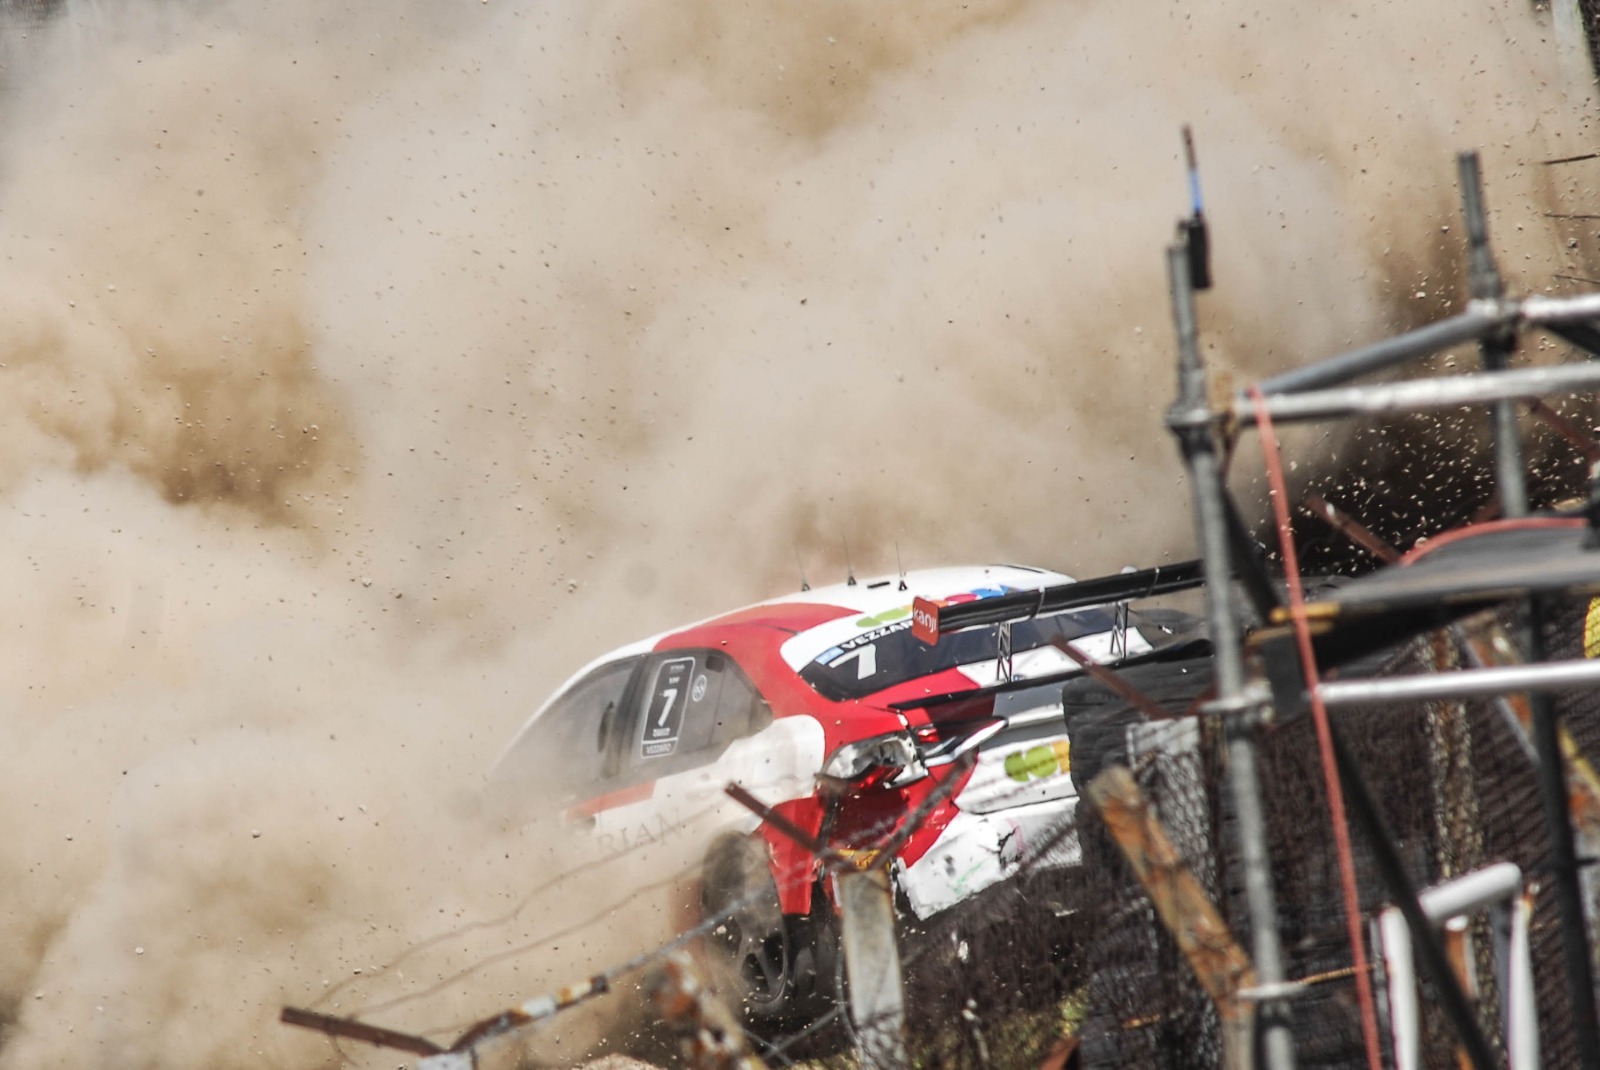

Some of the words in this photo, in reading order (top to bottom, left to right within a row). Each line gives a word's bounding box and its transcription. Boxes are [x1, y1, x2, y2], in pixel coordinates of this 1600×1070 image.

[913, 608, 937, 633] kanji
[828, 643, 876, 680] 7
[657, 688, 678, 727] 7
